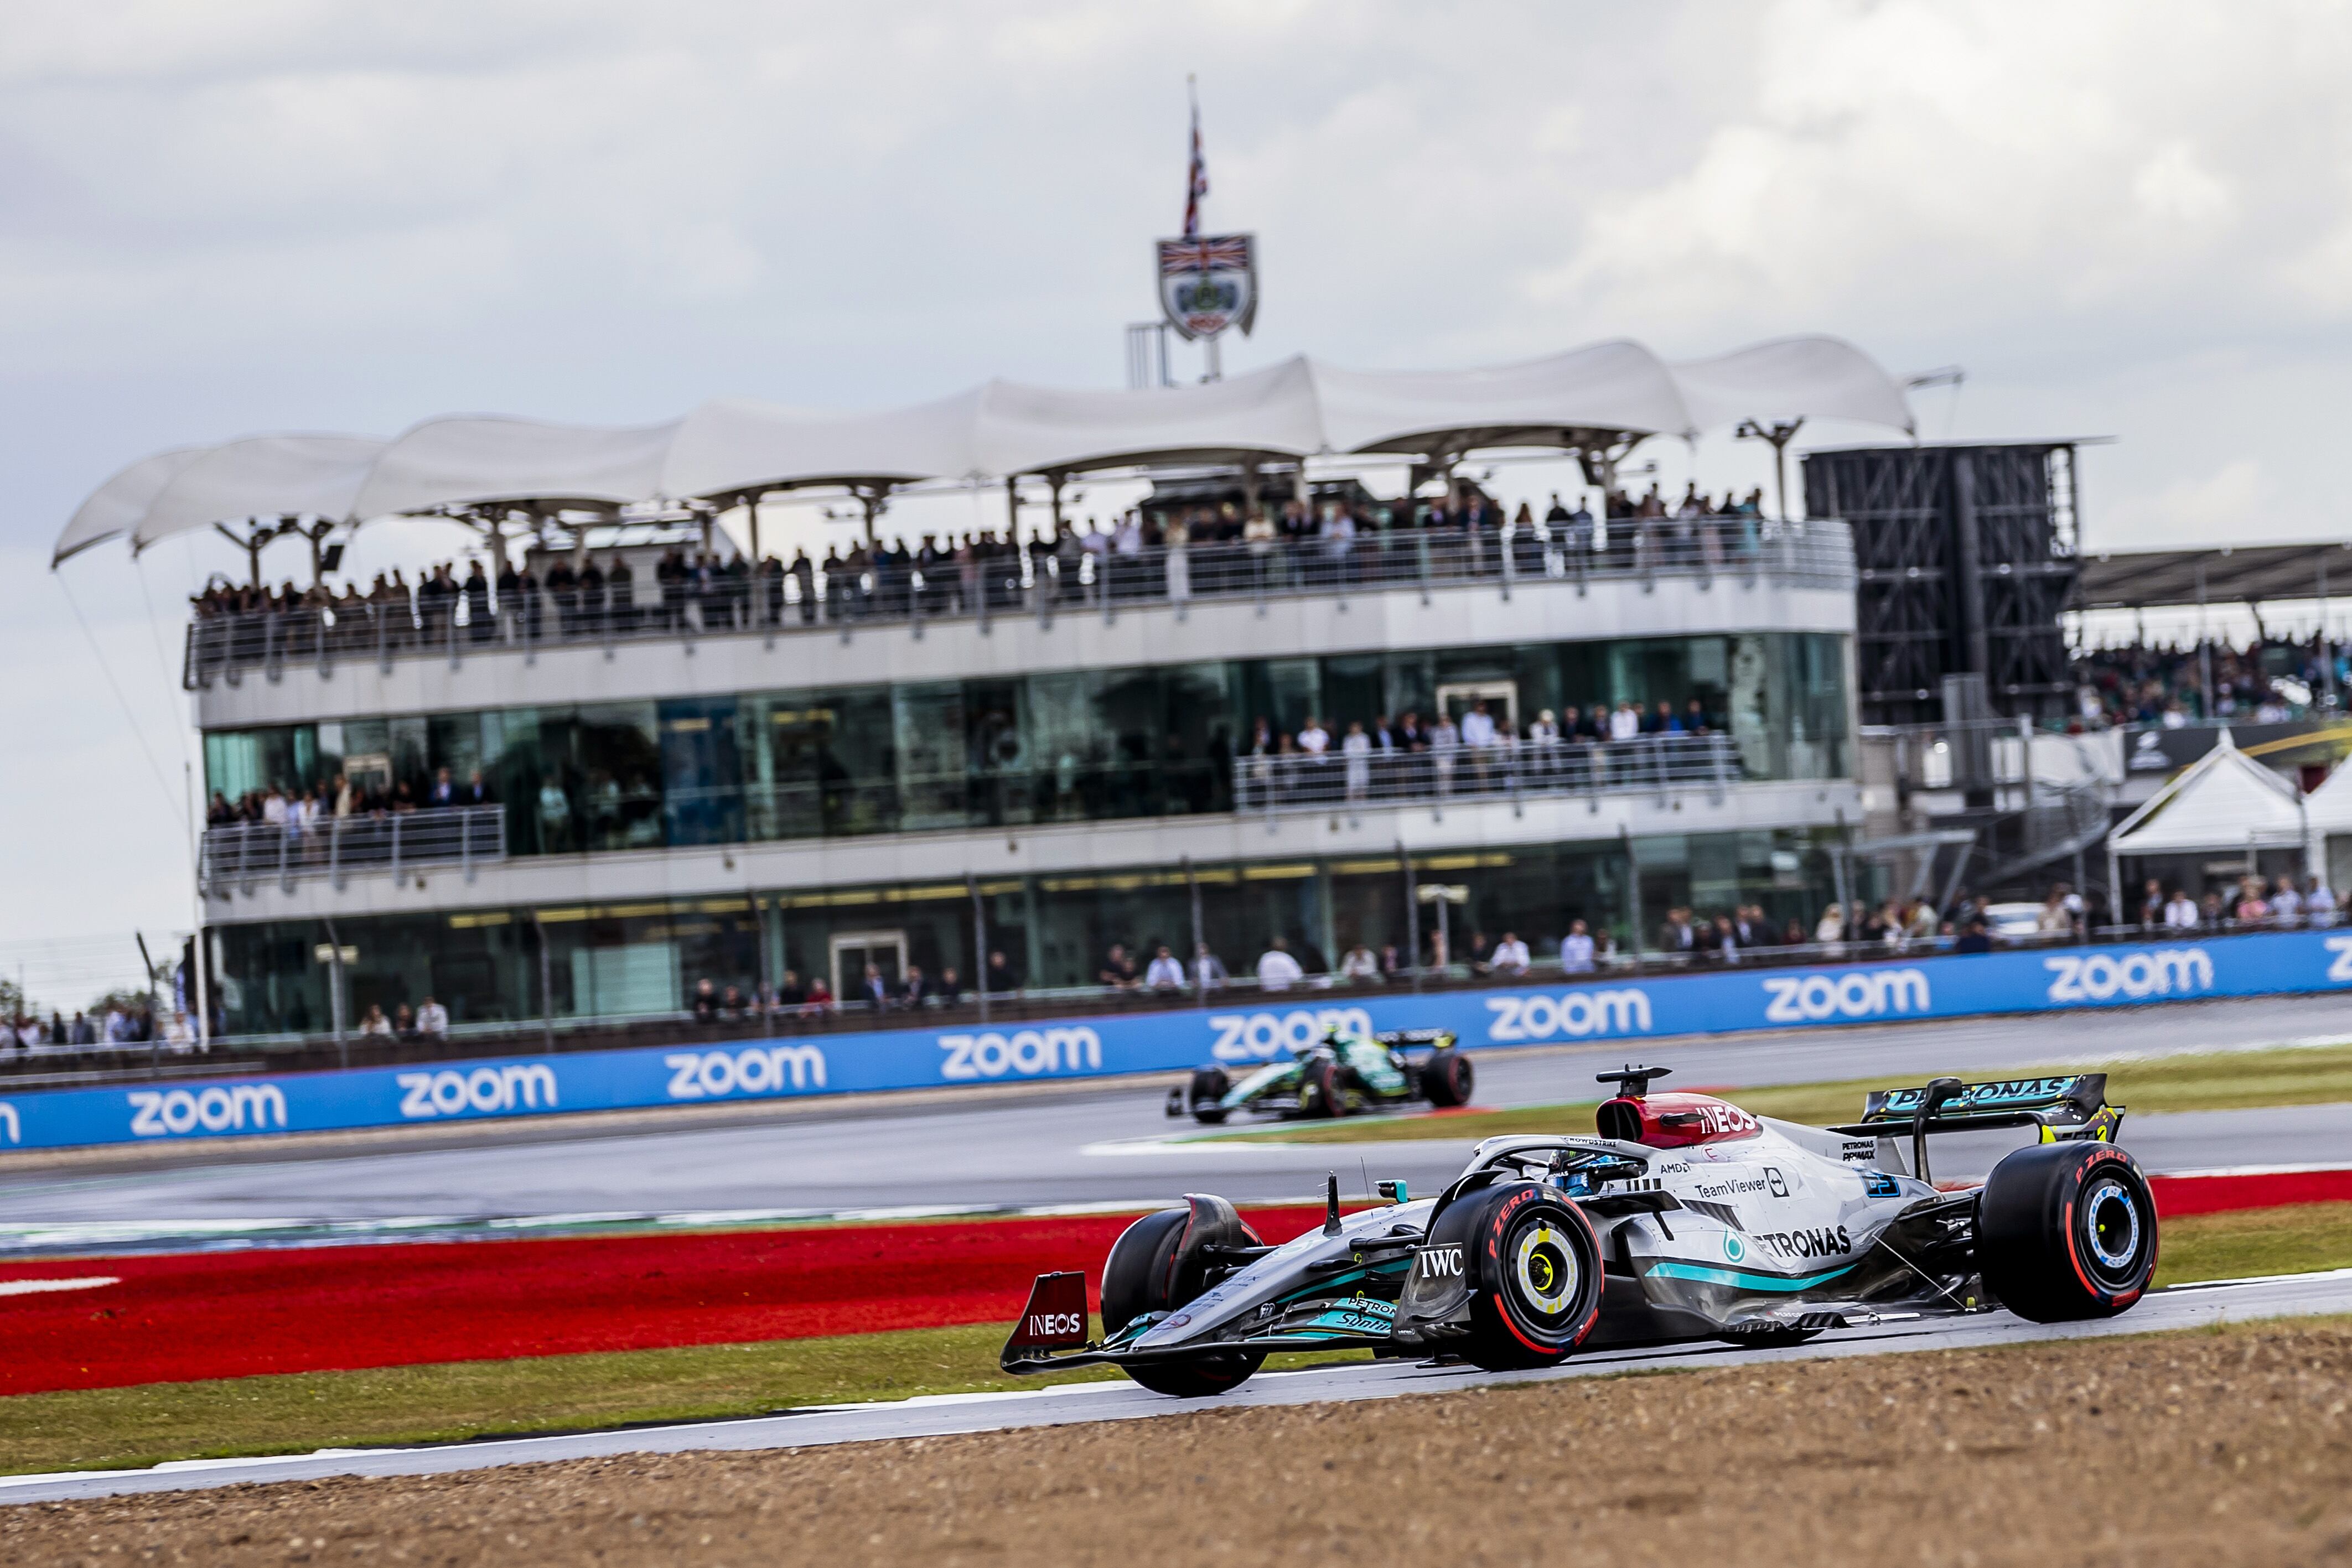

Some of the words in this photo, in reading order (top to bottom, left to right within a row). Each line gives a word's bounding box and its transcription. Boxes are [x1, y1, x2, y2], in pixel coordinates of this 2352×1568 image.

[2044, 948, 2214, 1001] zoom
[1763, 968, 1929, 1022] zoom
[1485, 988, 1652, 1040] zoom
[1209, 1008, 1374, 1060] zoom
[937, 1026, 1101, 1078] zoom
[665, 1045, 826, 1098] zoom
[397, 1065, 557, 1117] zoom
[1894, 1078, 2065, 1106] PEONAS
[128, 1084, 287, 1135] zoom
[1695, 1105, 1757, 1134] INEOS
[1564, 1137, 1617, 1148] CROWDSTRIKE
[1842, 1140, 1874, 1150] PETRONAS
[2085, 1150, 2127, 1170] ZERO
[1695, 1179, 1765, 1198] TeamViewer
[1492, 1189, 1534, 1238] ZERO
[1752, 1224, 1852, 1259] ETRONAS
[1420, 1248, 1463, 1278] IWC
[1336, 1313, 1391, 1331] Synti
[1348, 1297, 1397, 1315] PETRON
[1029, 1313, 1080, 1336] INEOS
